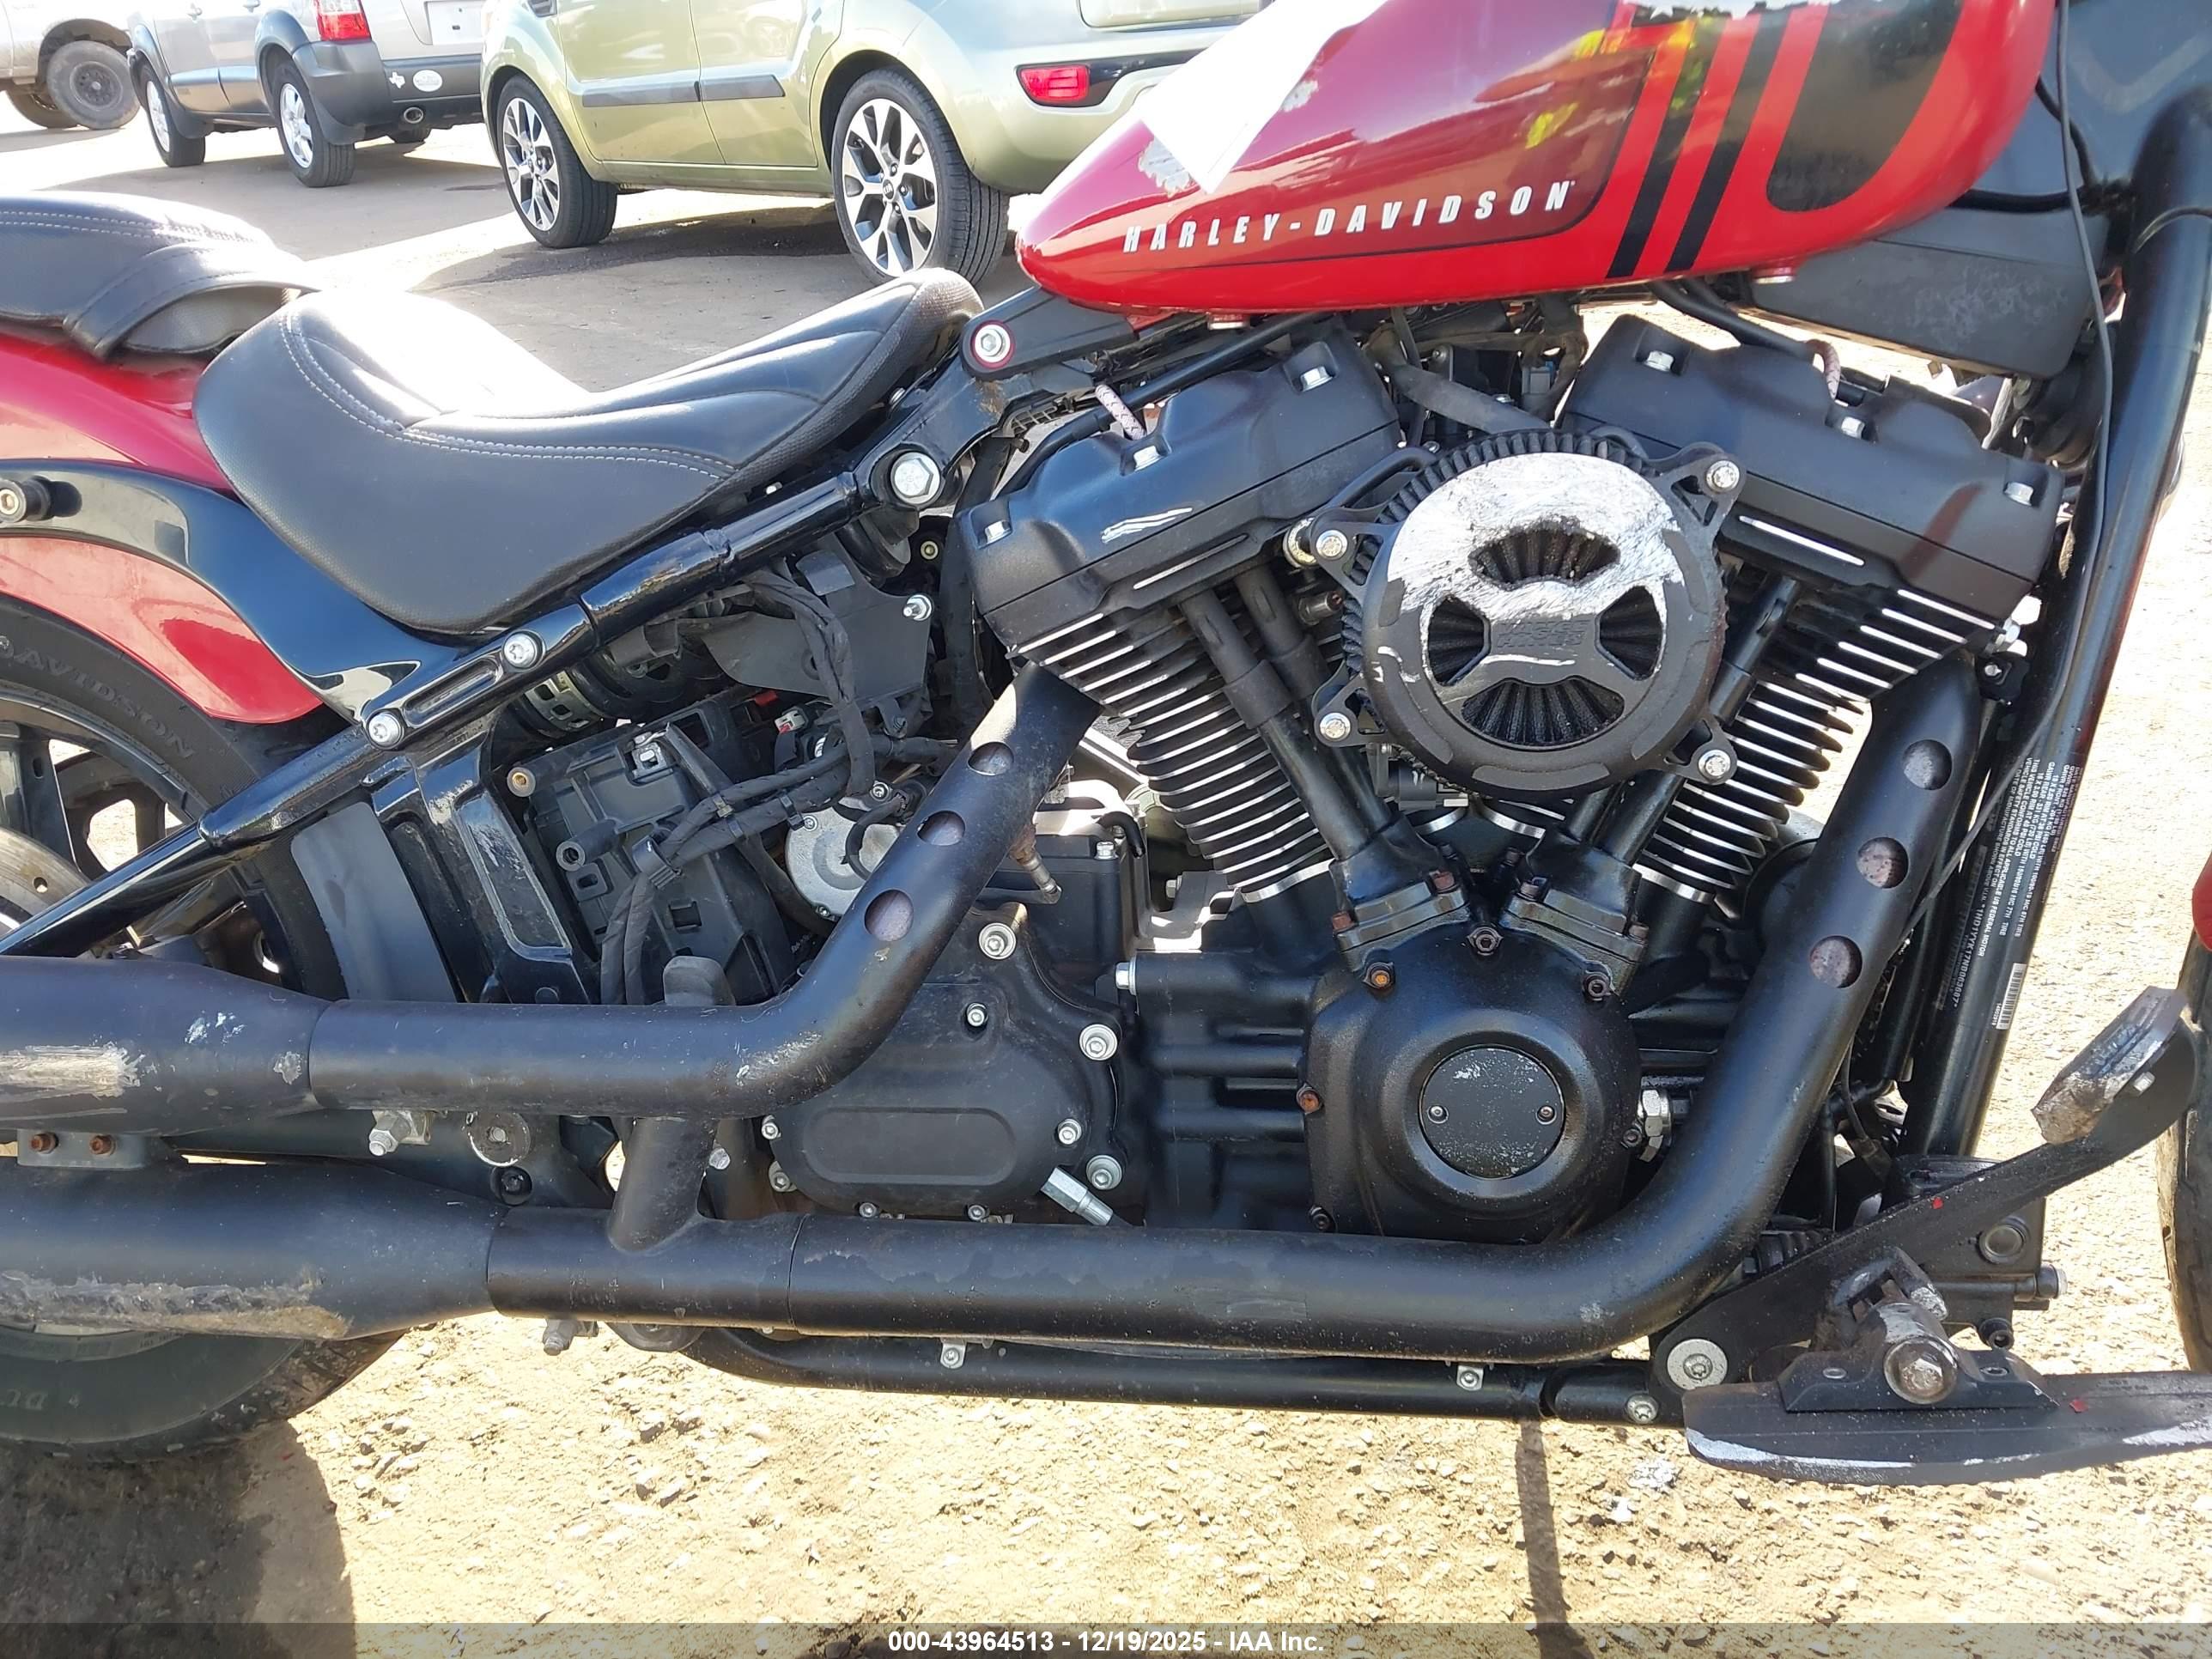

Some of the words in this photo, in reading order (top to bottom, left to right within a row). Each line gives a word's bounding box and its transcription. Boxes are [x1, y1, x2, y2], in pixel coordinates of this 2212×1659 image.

[1122, 179, 1575, 254] HARLEY-DAVIDSON
[2020, 757, 2033, 783] VEHICLE
[2030, 758, 2040, 772] THIS
[2044, 761, 2055, 781] GAWR
[2059, 763, 2069, 783] GAWR
[2012, 769, 2021, 785] DATE
[2022, 773, 2035, 799] VEHICLE
[2013, 783, 2025, 807] SAFETY
[2039, 781, 2050, 799] REAR
[2052, 784, 2063, 805] FRONT
[2027, 798, 2037, 810] RIM
[2042, 800, 2051, 812] RIM
[1996, 795, 2014, 841] MANUFACTURE
[2002, 808, 2018, 845] STANDARDS
[2012, 799, 2027, 836] CONFORMS
[2019, 827, 2028, 838] PSI
[2023, 837, 2033, 848] LB)
[2033, 830, 2043, 841] PSI
[1990, 842, 2000, 865] SHOWN
[2005, 845, 2014, 857] ALL
[2014, 838, 2025, 856] COLD
[2019, 848, 2030, 864] WITH
[2028, 841, 2039, 859] COLD
[1993, 853, 2005, 878] EFFECT
[2033, 855, 2043, 871] WITH
[1983, 865, 1994, 886] ABOVE
[1994, 858, 2010, 896] APPLICABLE
[1984, 905, 1997, 933] FEDERAL
[1998, 921, 2008, 935] TIRE
[2014, 923, 2023, 937] TIRE
[1977, 933, 1989, 957] MOTOR
